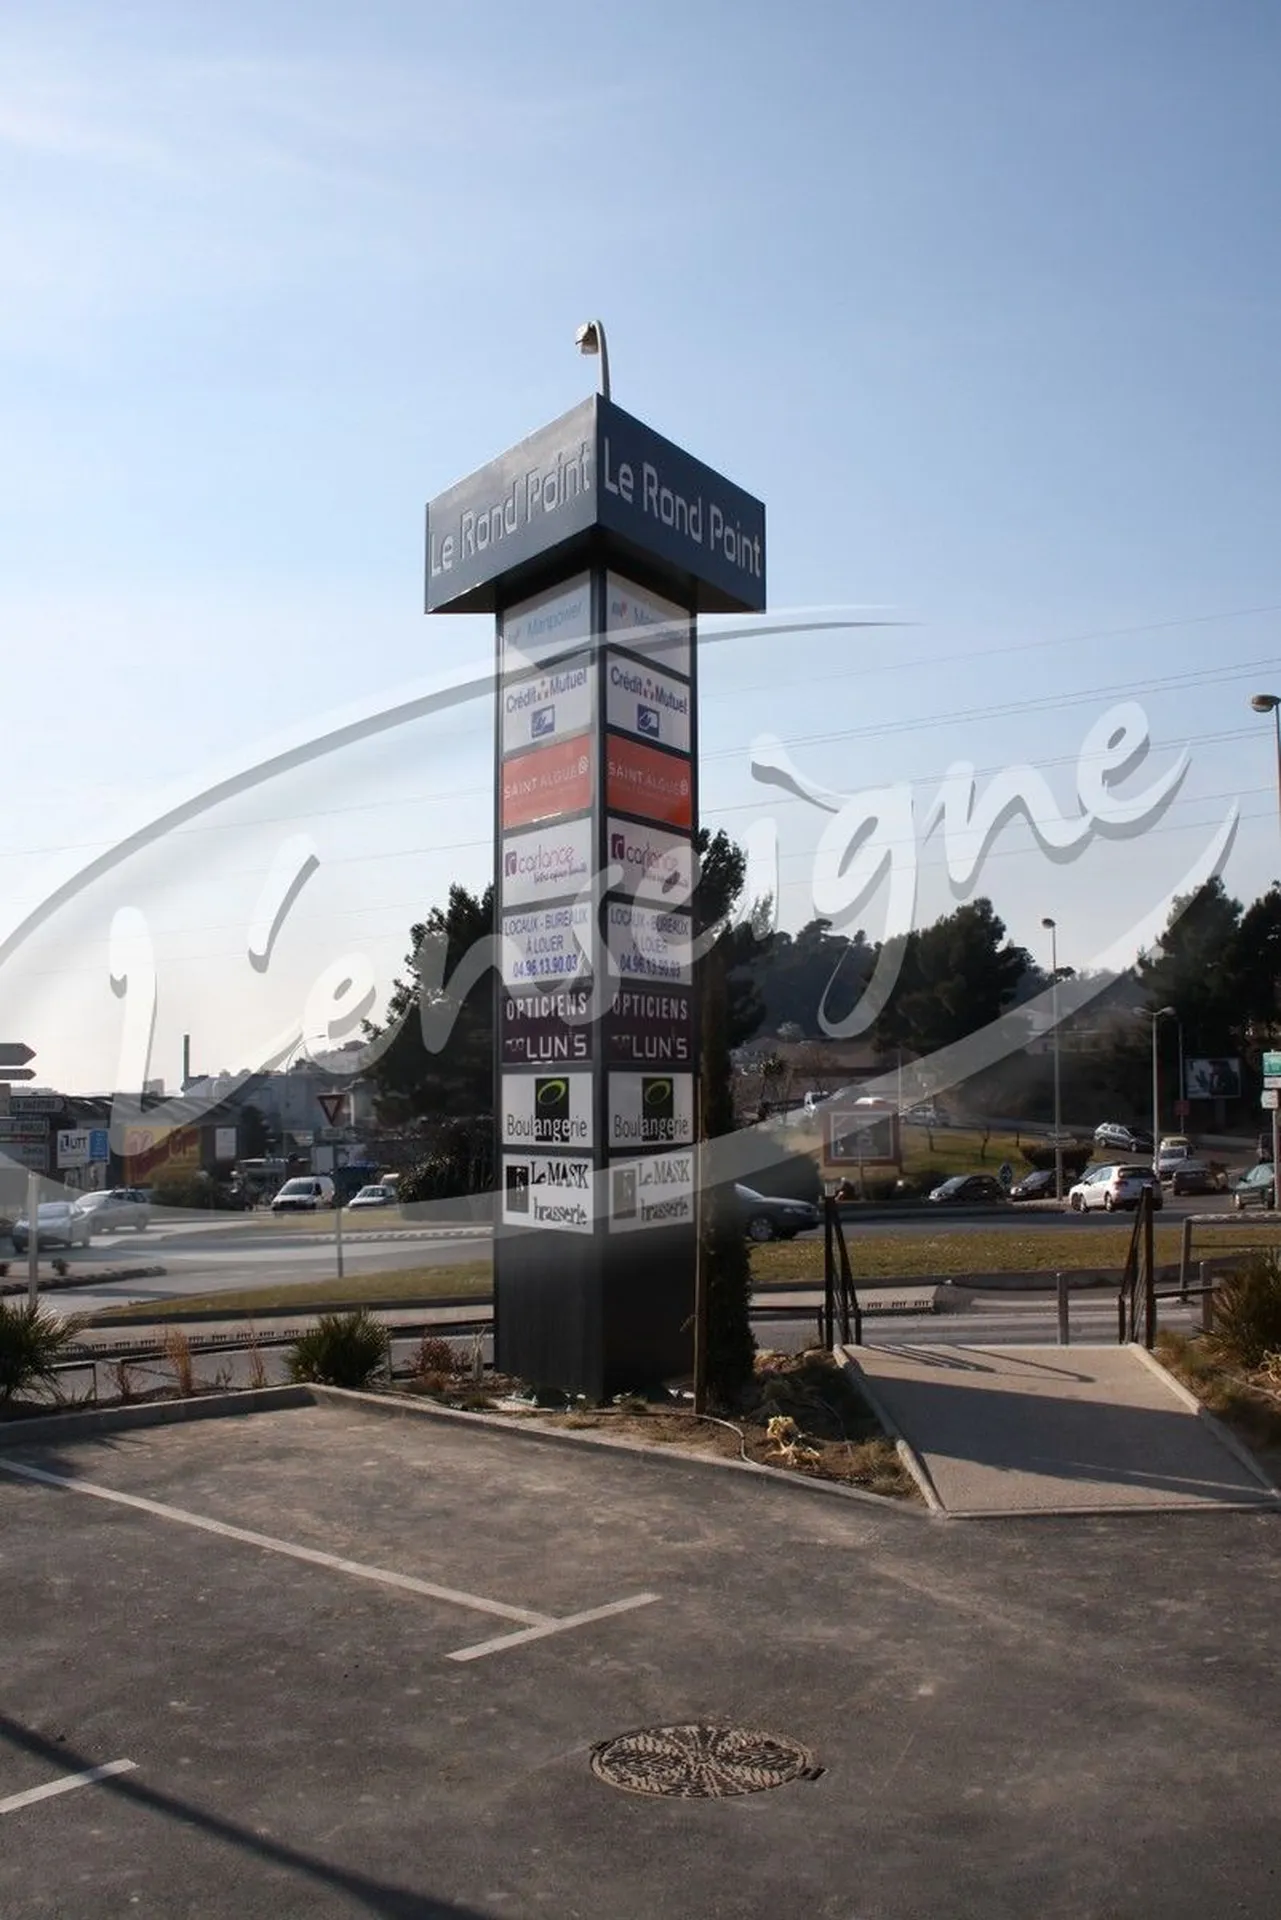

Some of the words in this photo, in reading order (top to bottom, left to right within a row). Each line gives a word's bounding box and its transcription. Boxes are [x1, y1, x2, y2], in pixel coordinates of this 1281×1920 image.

[430, 531, 453, 577] Le
[460, 479, 518, 561] Rond
[525, 439, 590, 526] Point
[604, 437, 634, 503] Le
[643, 461, 702, 544] Rond
[710, 503, 761, 578] Point
[550, 667, 587, 694] Mutuel
[610, 666, 643, 696] Crédit
[655, 685, 688, 714] Mutuel
[608, 761, 643, 784] SAINT
[504, 778, 537, 800] SAINT
[504, 915, 537, 936] LOCAUX
[545, 907, 588, 931] BUREAUX
[610, 907, 645, 928] LOCAUX
[533, 934, 564, 953] LOUER
[506, 992, 587, 1020] OPTICIENS
[612, 992, 687, 1020] OPTICIENS
[507, 1114, 587, 1142] Boulangerie
[614, 1114, 689, 1141] Boulangerie
[531, 1161, 546, 1185] Le
[547, 1162, 589, 1189] MASK
[653, 1160, 690, 1185] MASK
[534, 1197, 587, 1225] brasserie
[640, 1197, 689, 1222] brasserie
